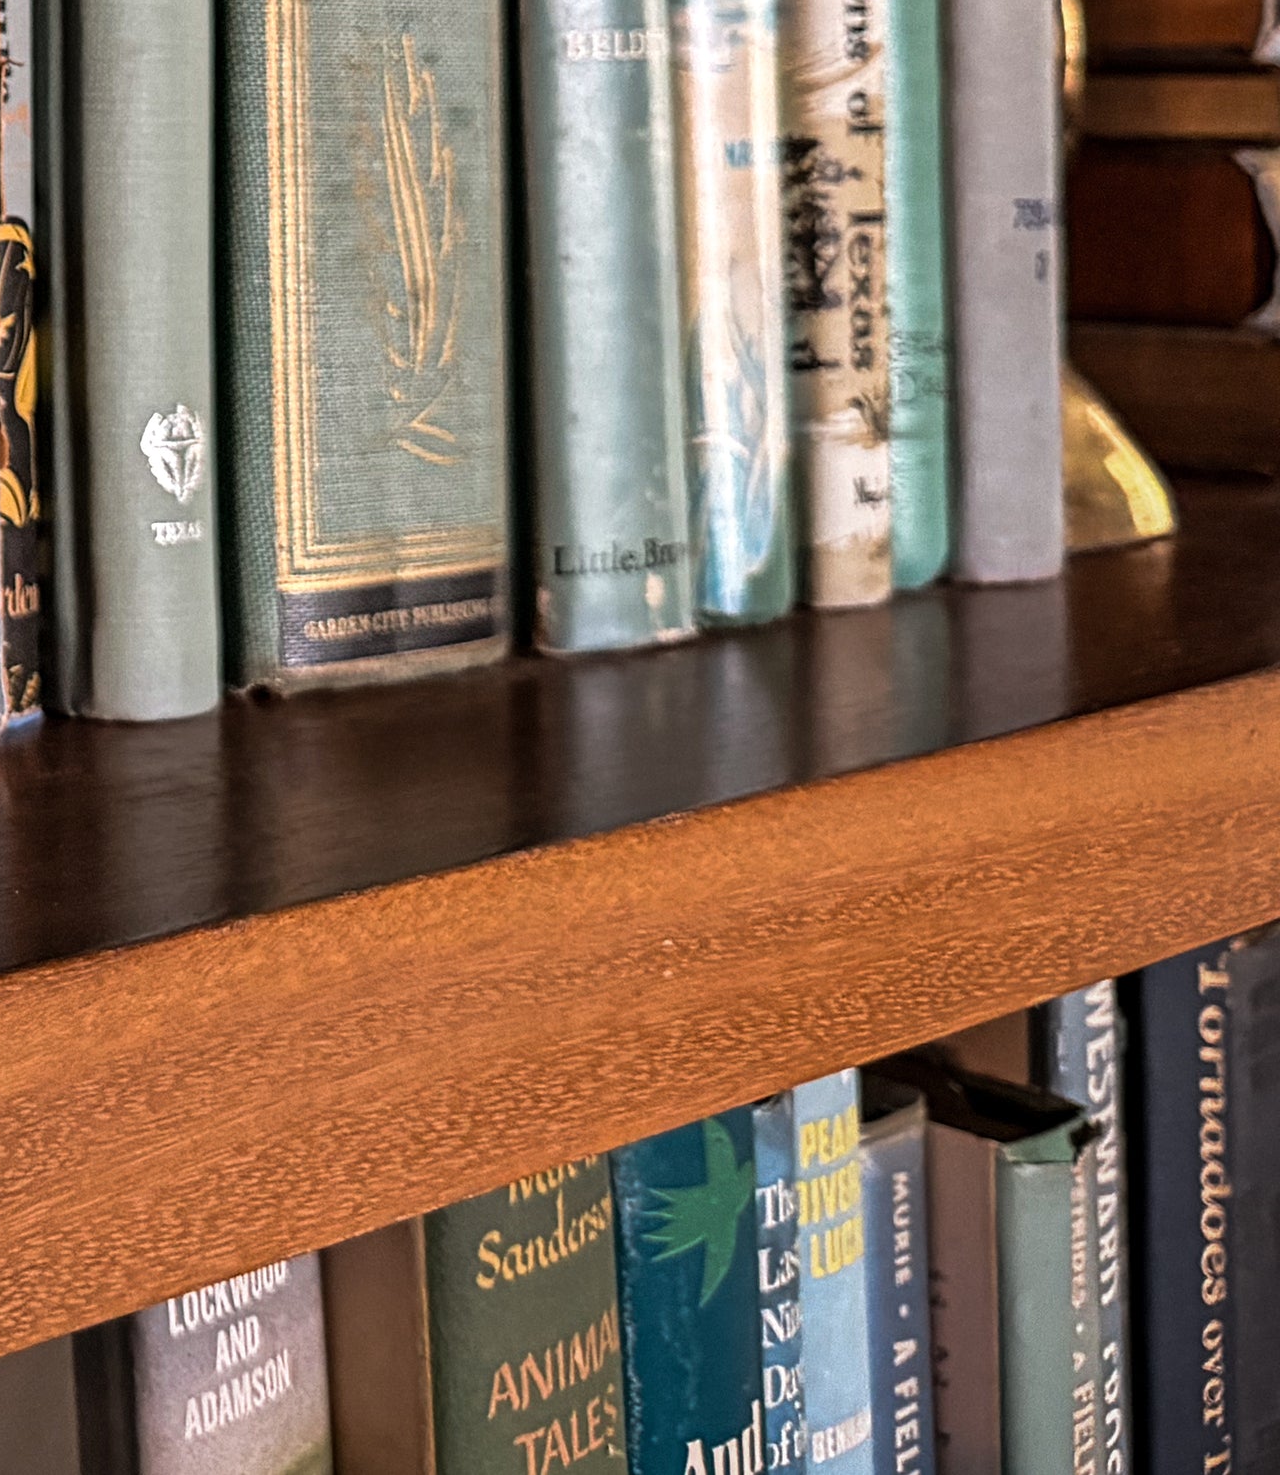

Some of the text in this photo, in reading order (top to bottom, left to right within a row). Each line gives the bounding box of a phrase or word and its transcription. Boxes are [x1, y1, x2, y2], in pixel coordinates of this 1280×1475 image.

[1197, 960, 1233, 1307] Tornadoes
[215, 1314, 260, 1374] AND
[891, 1337, 919, 1367] A
[1201, 1319, 1227, 1427] over
[183, 1348, 292, 1441] ADAMSON
[893, 1376, 925, 1475] FIEL
